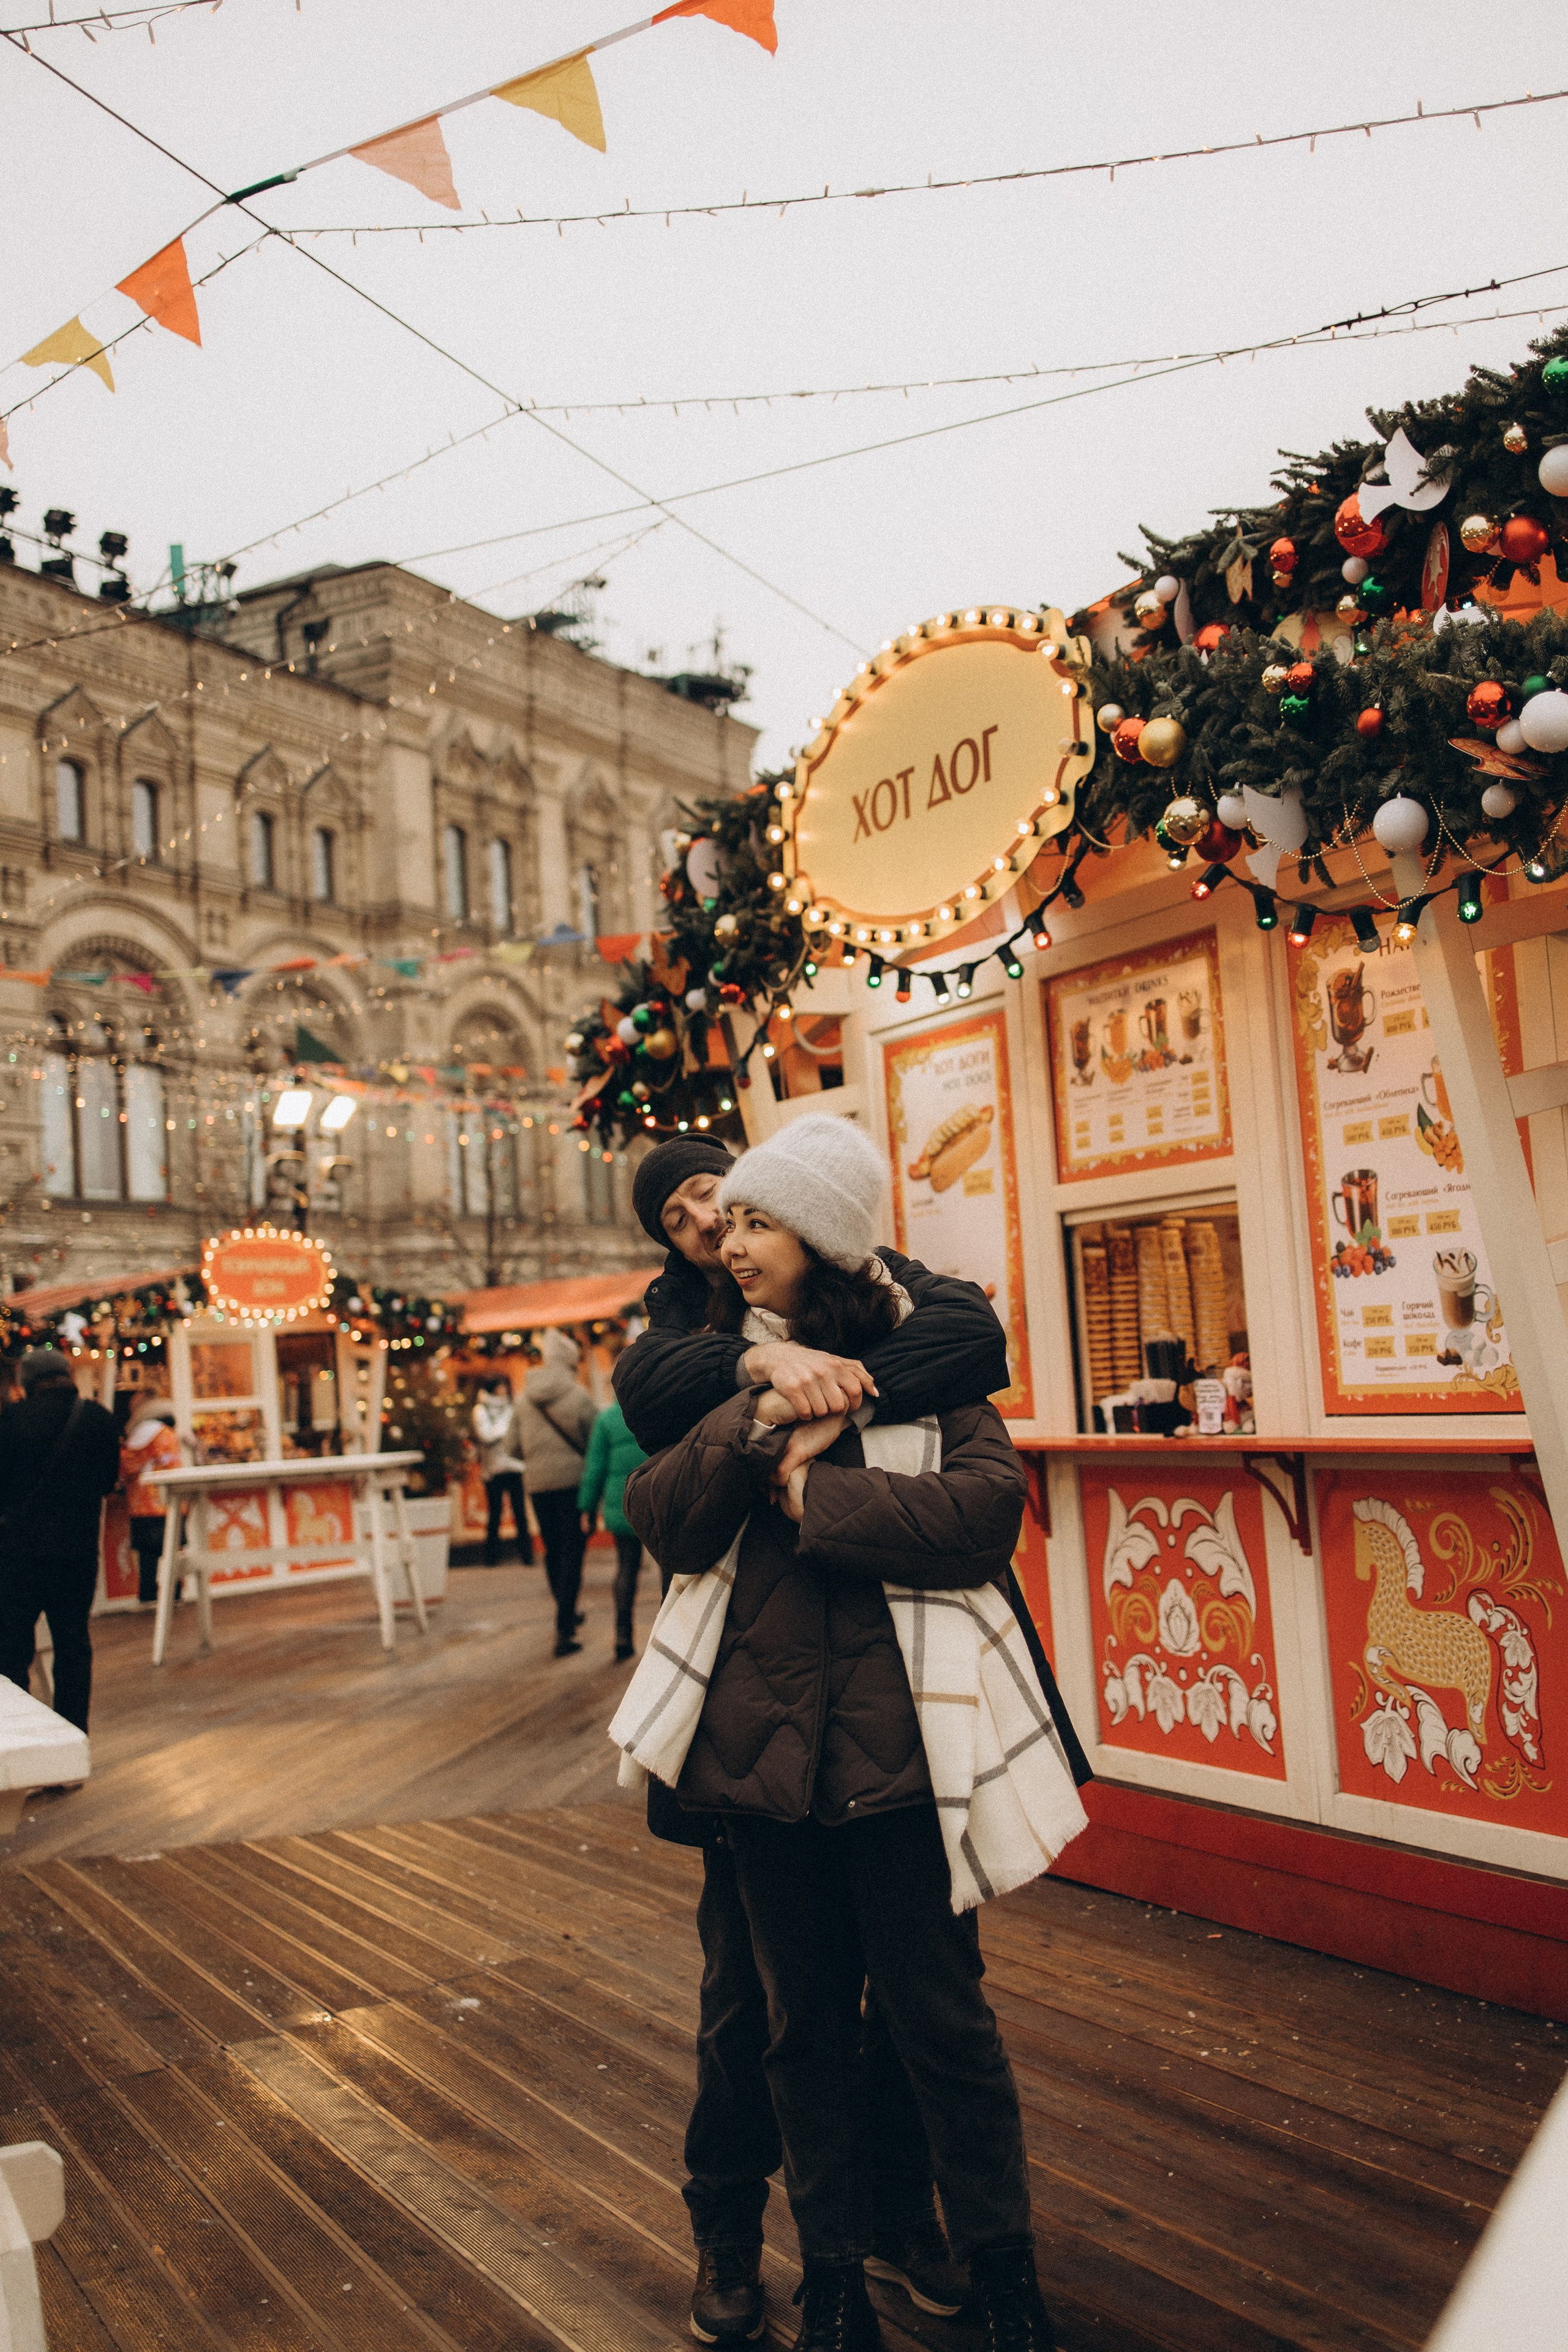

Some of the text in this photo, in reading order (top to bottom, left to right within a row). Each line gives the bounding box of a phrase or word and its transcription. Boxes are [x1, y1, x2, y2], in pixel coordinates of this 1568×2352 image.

[852, 725, 998, 843] ХОТ ДОГ
[1385, 1186, 1438, 1201] Согревающий
[1401, 1300, 1434, 1311] Горячий
